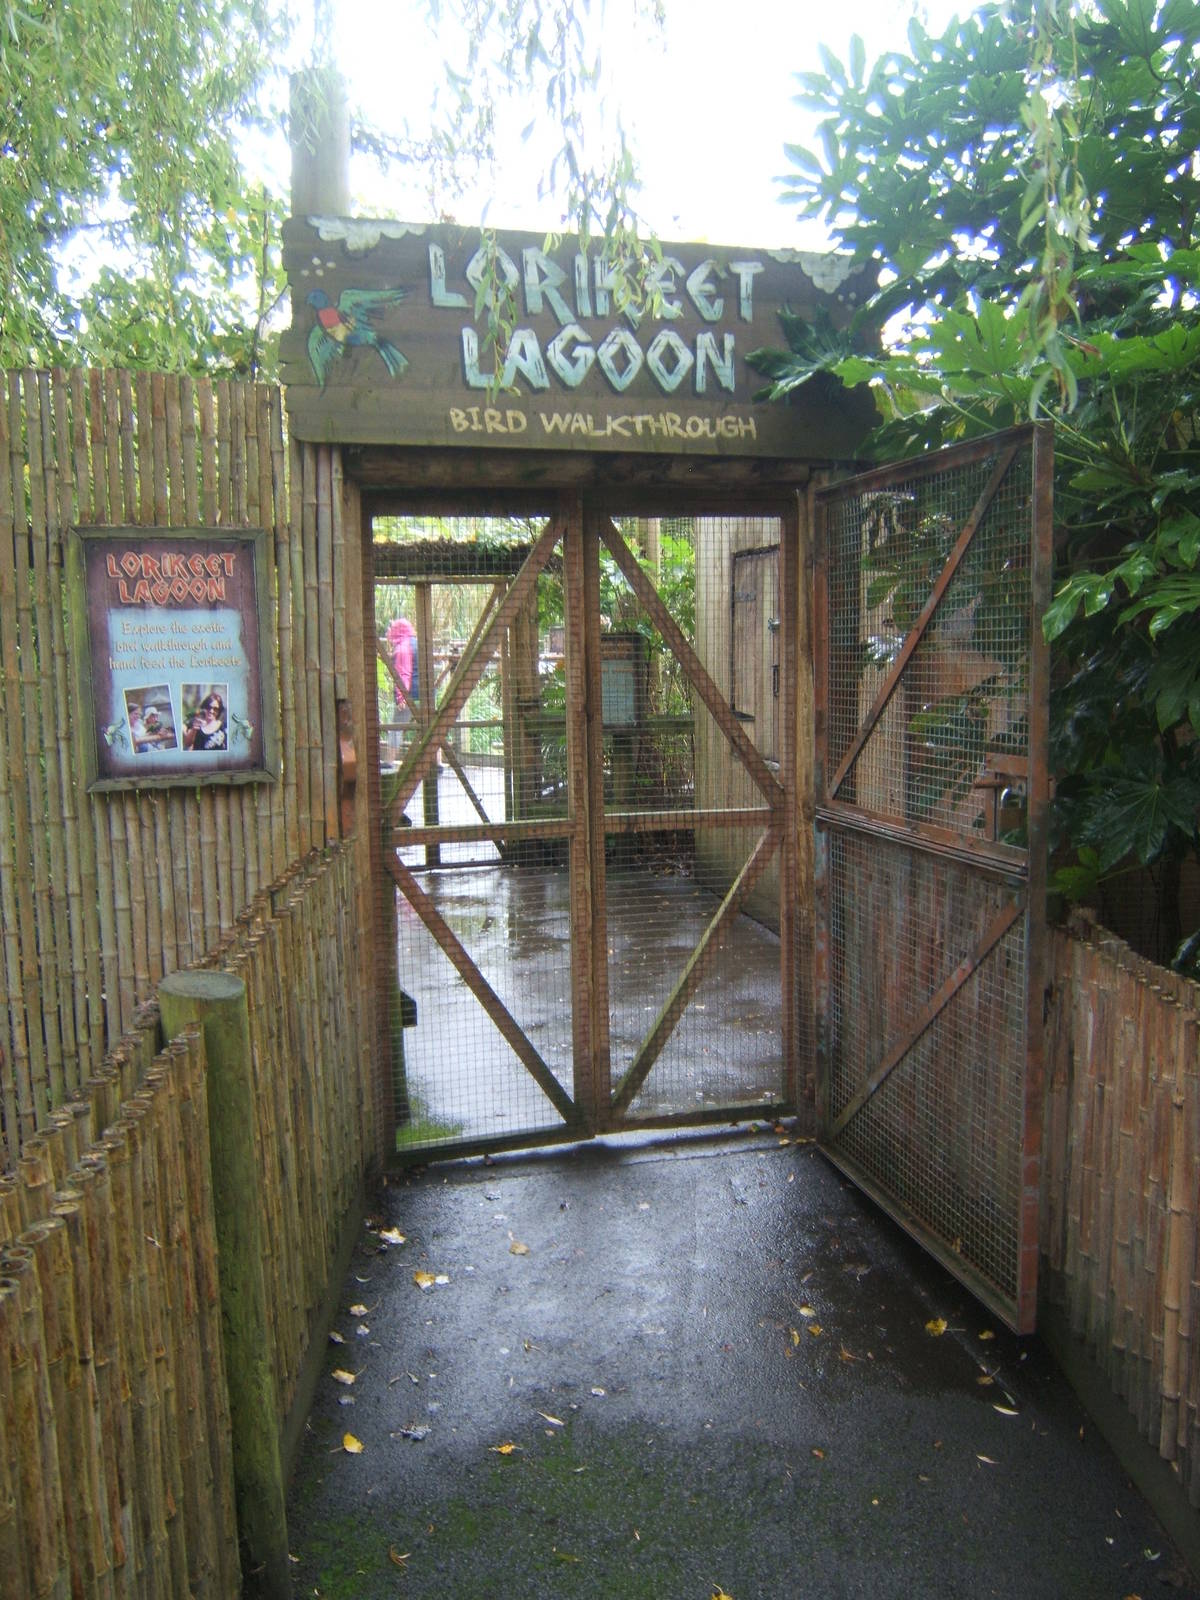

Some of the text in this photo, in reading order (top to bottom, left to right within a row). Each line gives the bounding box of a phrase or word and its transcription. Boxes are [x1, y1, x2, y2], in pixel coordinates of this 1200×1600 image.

[428, 243, 765, 331] LORIKEET
[461, 323, 736, 393] LAGOON
[449, 406, 757, 440] BIRD WALKTHROUGH
[106, 551, 236, 583] LORIKEET
[118, 577, 226, 605] LAGOON
[170, 620, 187, 633] the
[211, 639, 232, 650] and
[109, 656, 137, 671] hand
[141, 655, 165, 669] feed
[169, 656, 185, 668] the
